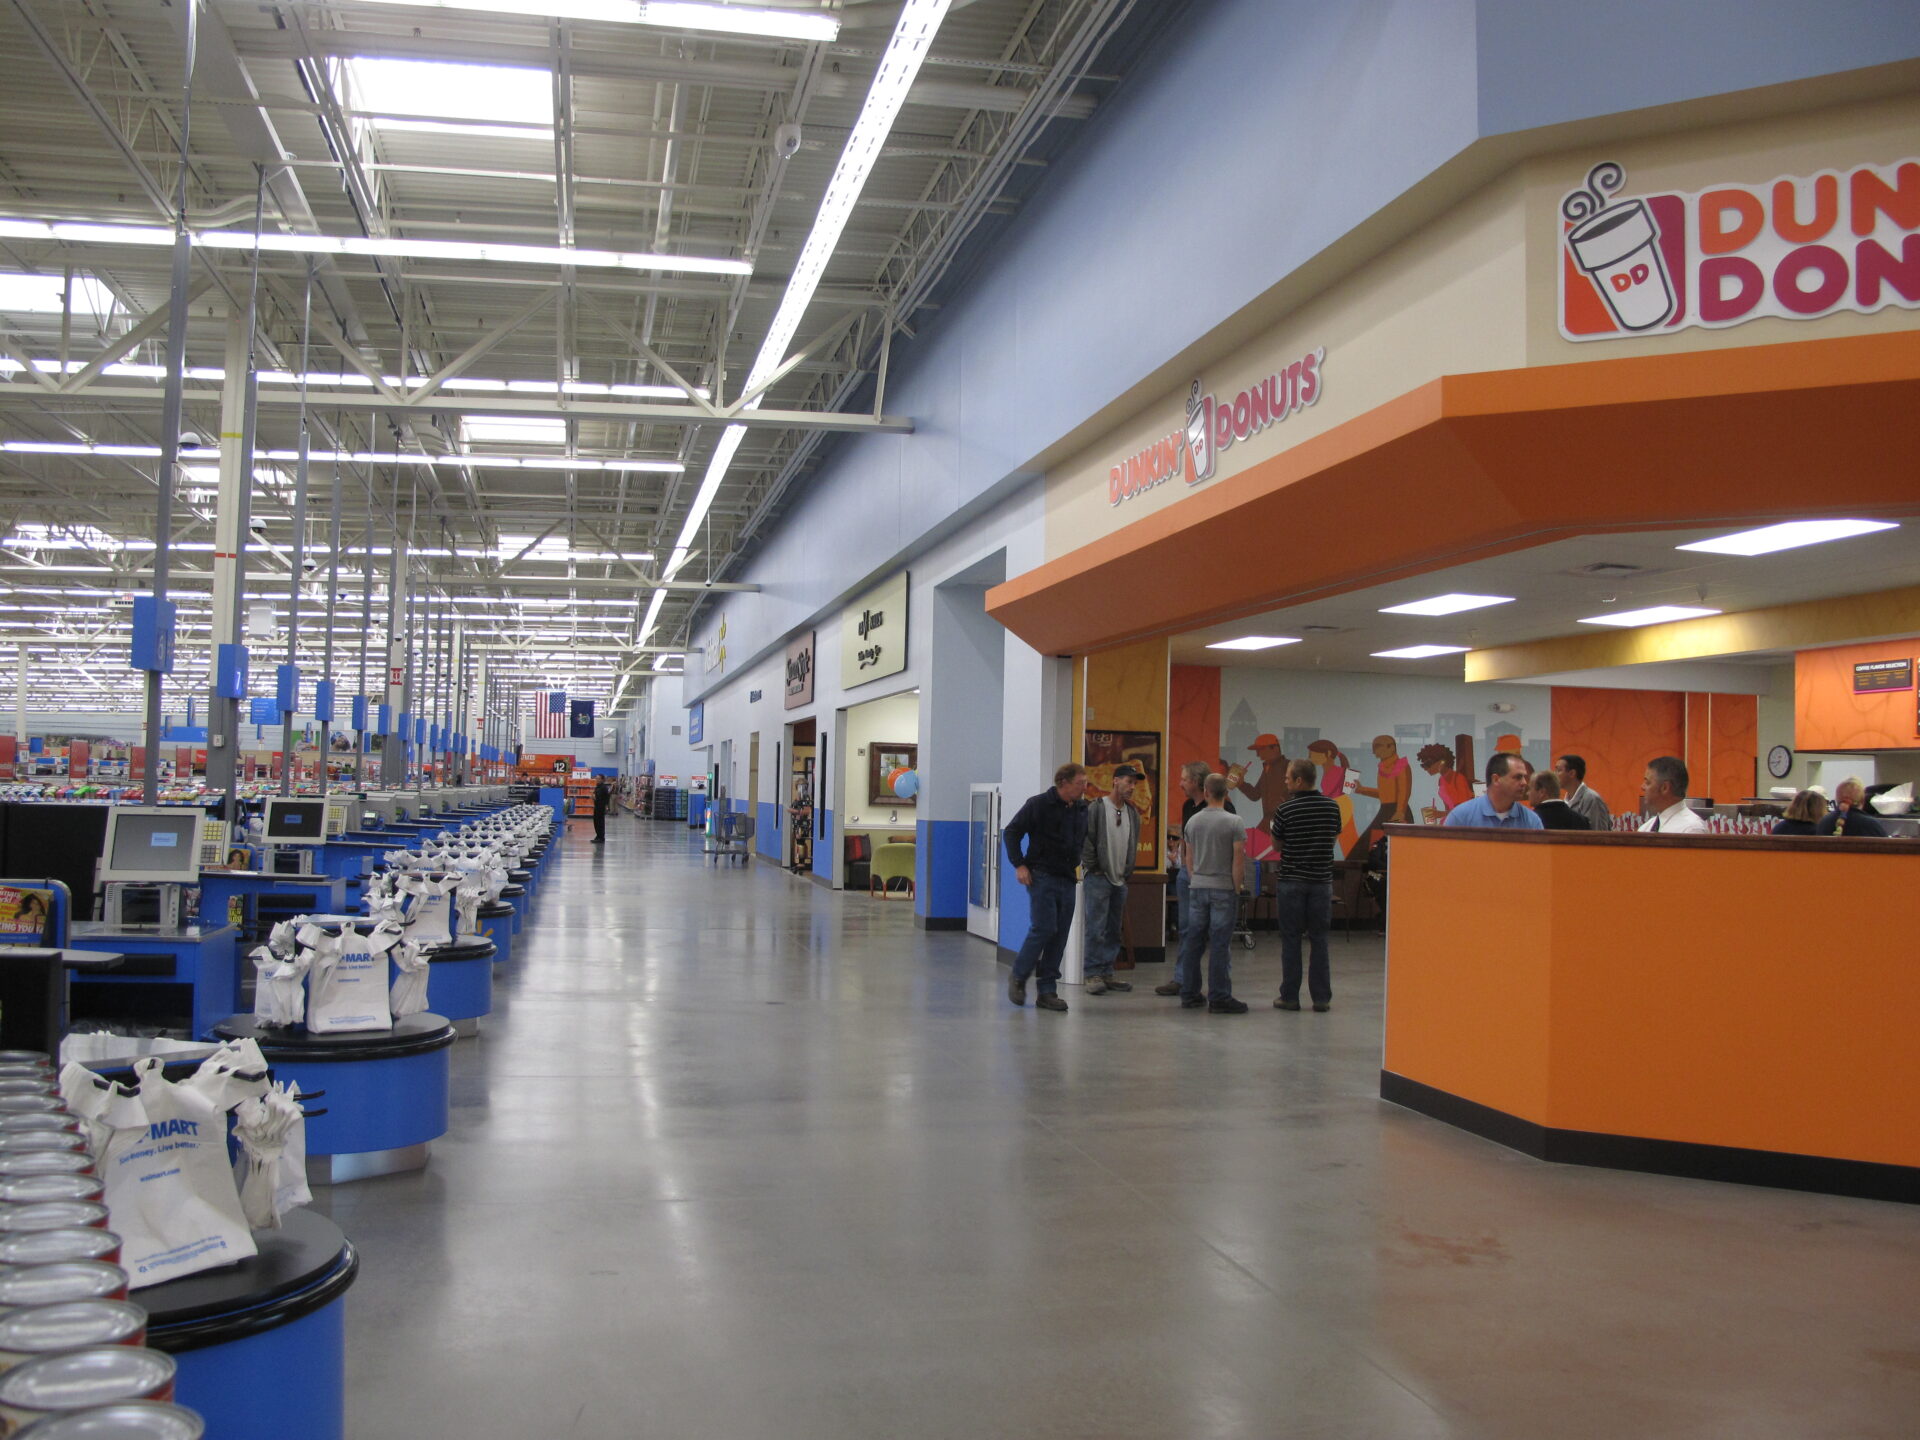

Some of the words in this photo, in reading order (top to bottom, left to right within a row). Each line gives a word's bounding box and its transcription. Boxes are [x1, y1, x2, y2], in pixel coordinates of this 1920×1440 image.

[1698, 162, 1920, 256] DUN
[1610, 263, 1649, 293] DD
[1698, 233, 1920, 322] DON
[1108, 430, 1185, 505] DUNKIN'
[1215, 353, 1317, 449] DONUTS
[1195, 440, 1204, 456] DD
[1886, 661, 1907, 669] SELECTION
[235, 670, 241, 691] 7
[158, 1143, 174, 1153] Live
